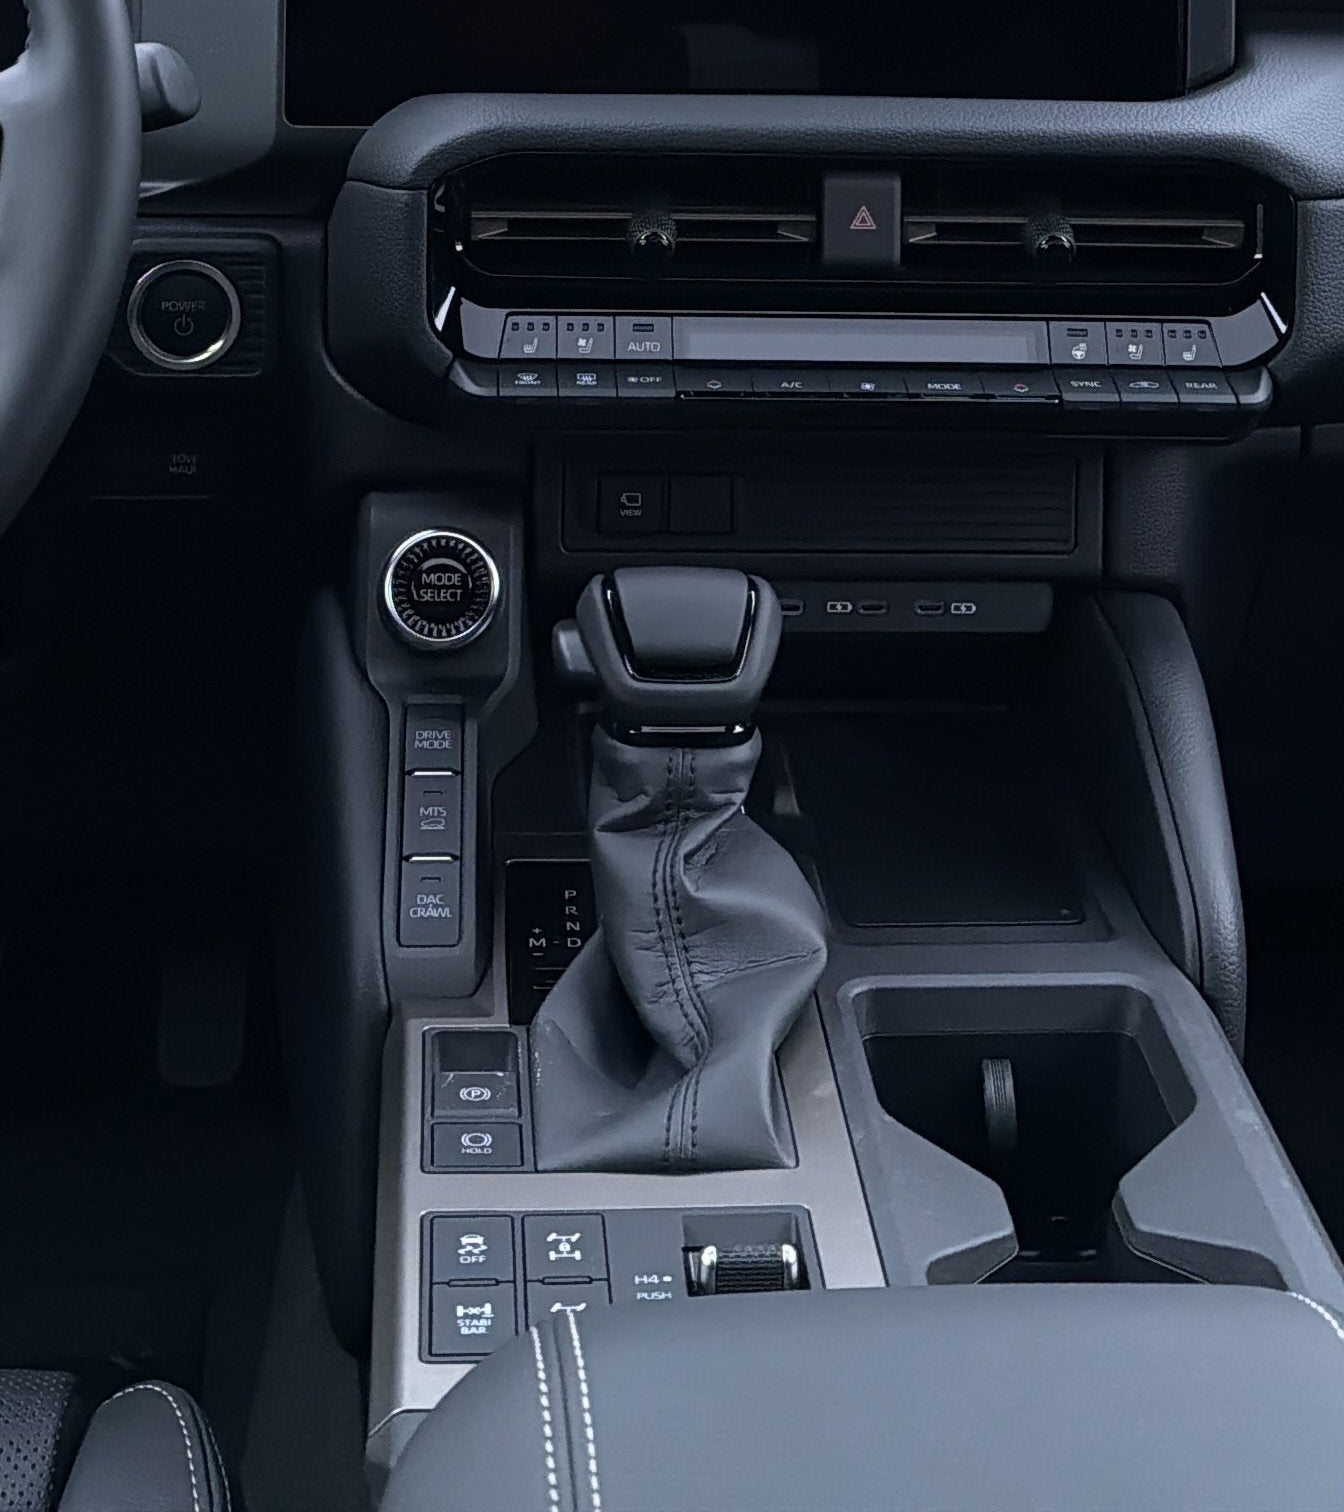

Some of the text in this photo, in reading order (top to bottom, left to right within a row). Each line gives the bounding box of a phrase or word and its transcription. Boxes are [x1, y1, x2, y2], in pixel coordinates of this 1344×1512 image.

[161, 300, 207, 313] POWER
[627, 341, 661, 353] AUTO
[639, 376, 663, 384] OFF
[780, 380, 804, 390] A/C
[1070, 379, 1102, 389] SYNC
[1184, 380, 1219, 390] REAR
[927, 382, 962, 391] MODE
[619, 508, 642, 517] VIEW
[421, 572, 462, 586] MODE
[419, 589, 463, 602] SELECT
[415, 730, 452, 740] DRIVE
[414, 739, 453, 750] MODE
[419, 806, 447, 817] MTS
[416, 894, 445, 906] DAC
[564, 889, 577, 900] P
[409, 906, 453, 919] CRAWL
[565, 905, 579, 916] R
[566, 921, 581, 932] N
[528, 937, 582, 948] M D
[461, 1147, 493, 1155] HOLD
[459, 1255, 487, 1264] OFF
[634, 1274, 660, 1285] H4
[636, 1291, 673, 1300] PUSH
[456, 1319, 492, 1327] STABI
[460, 1326, 487, 1335] BAR
